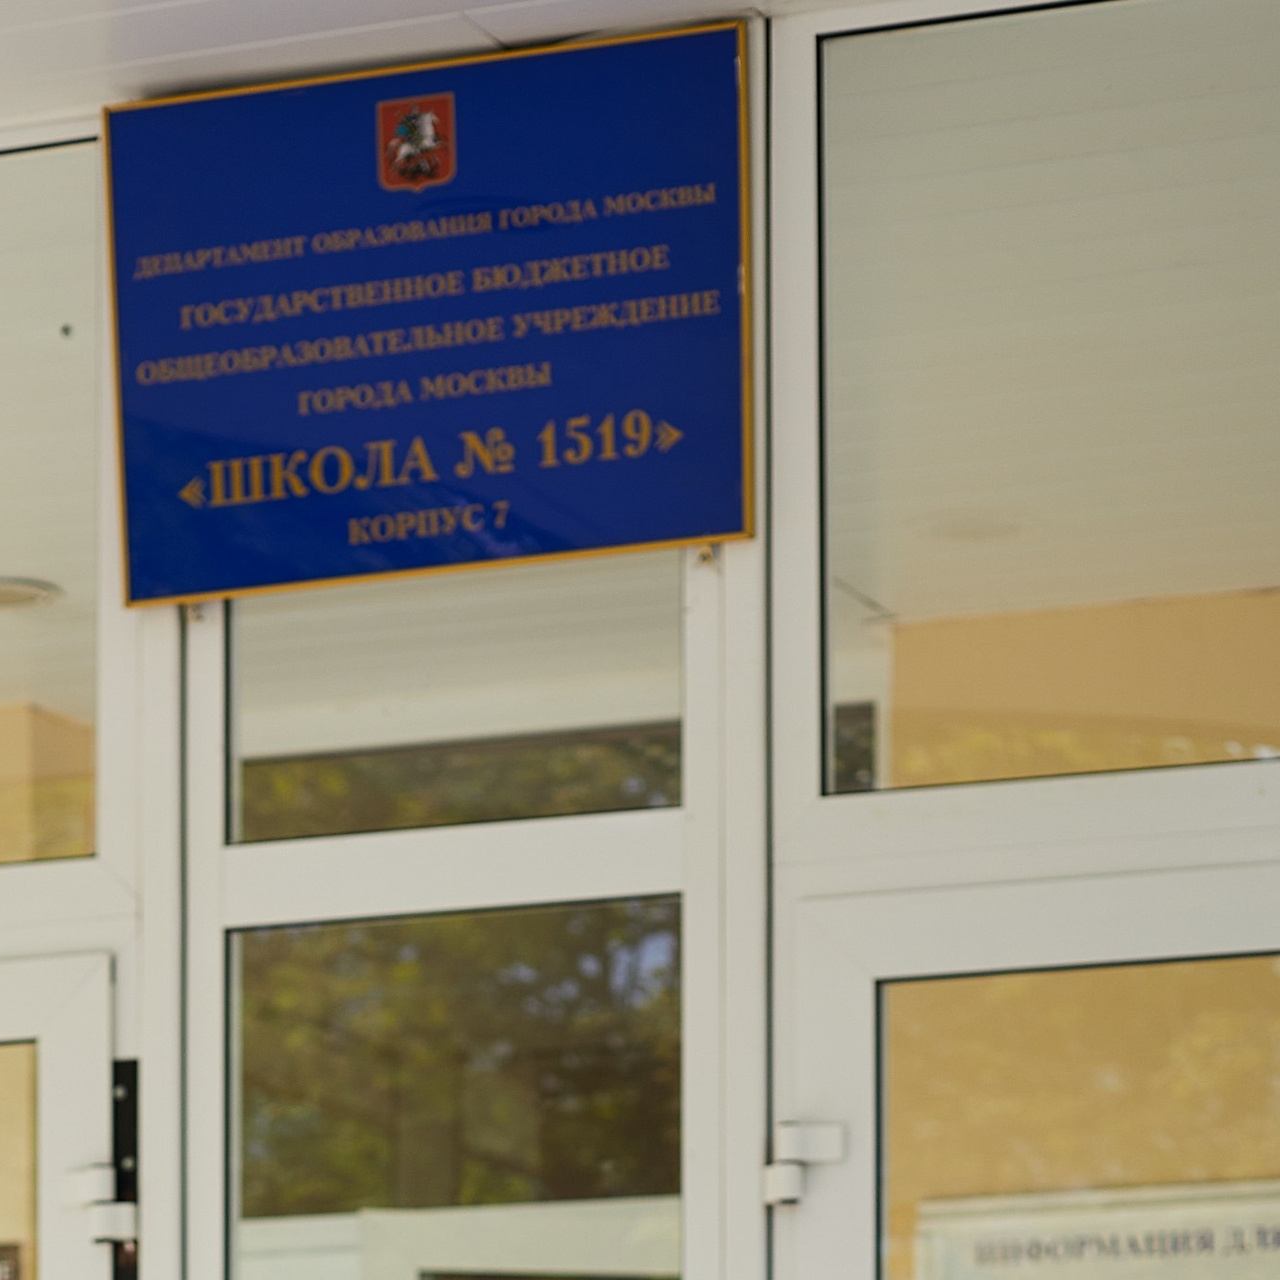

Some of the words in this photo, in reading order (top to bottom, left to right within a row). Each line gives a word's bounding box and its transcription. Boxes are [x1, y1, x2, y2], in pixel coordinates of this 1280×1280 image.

[132, 234, 307, 280] ДЕПАРТАМЕНТ
[311, 211, 493, 254] ОБРАЗОВАНИЯ
[498, 198, 598, 230] ГОРОДА
[604, 182, 717, 217] МОСКВЫ
[180, 270, 465, 330] ГОСУДАРСТВЕННОЕ
[471, 244, 670, 293] БЮДЖЕТНОЕ
[135, 316, 504, 386] ОБЩЕОБРАЗОВАТЕЛЬНОЕ
[511, 289, 720, 338] УЧРЕЖДЕНИЕ
[297, 379, 413, 417] ГОРОДА
[420, 361, 552, 401] МОСКВЫ
[177, 435, 440, 510] «ШКОЛА
[454, 426, 515, 479] №
[536, 408, 684, 468] 1519»
[348, 503, 486, 546] КОРПУС
[491, 499, 510, 530] 7
